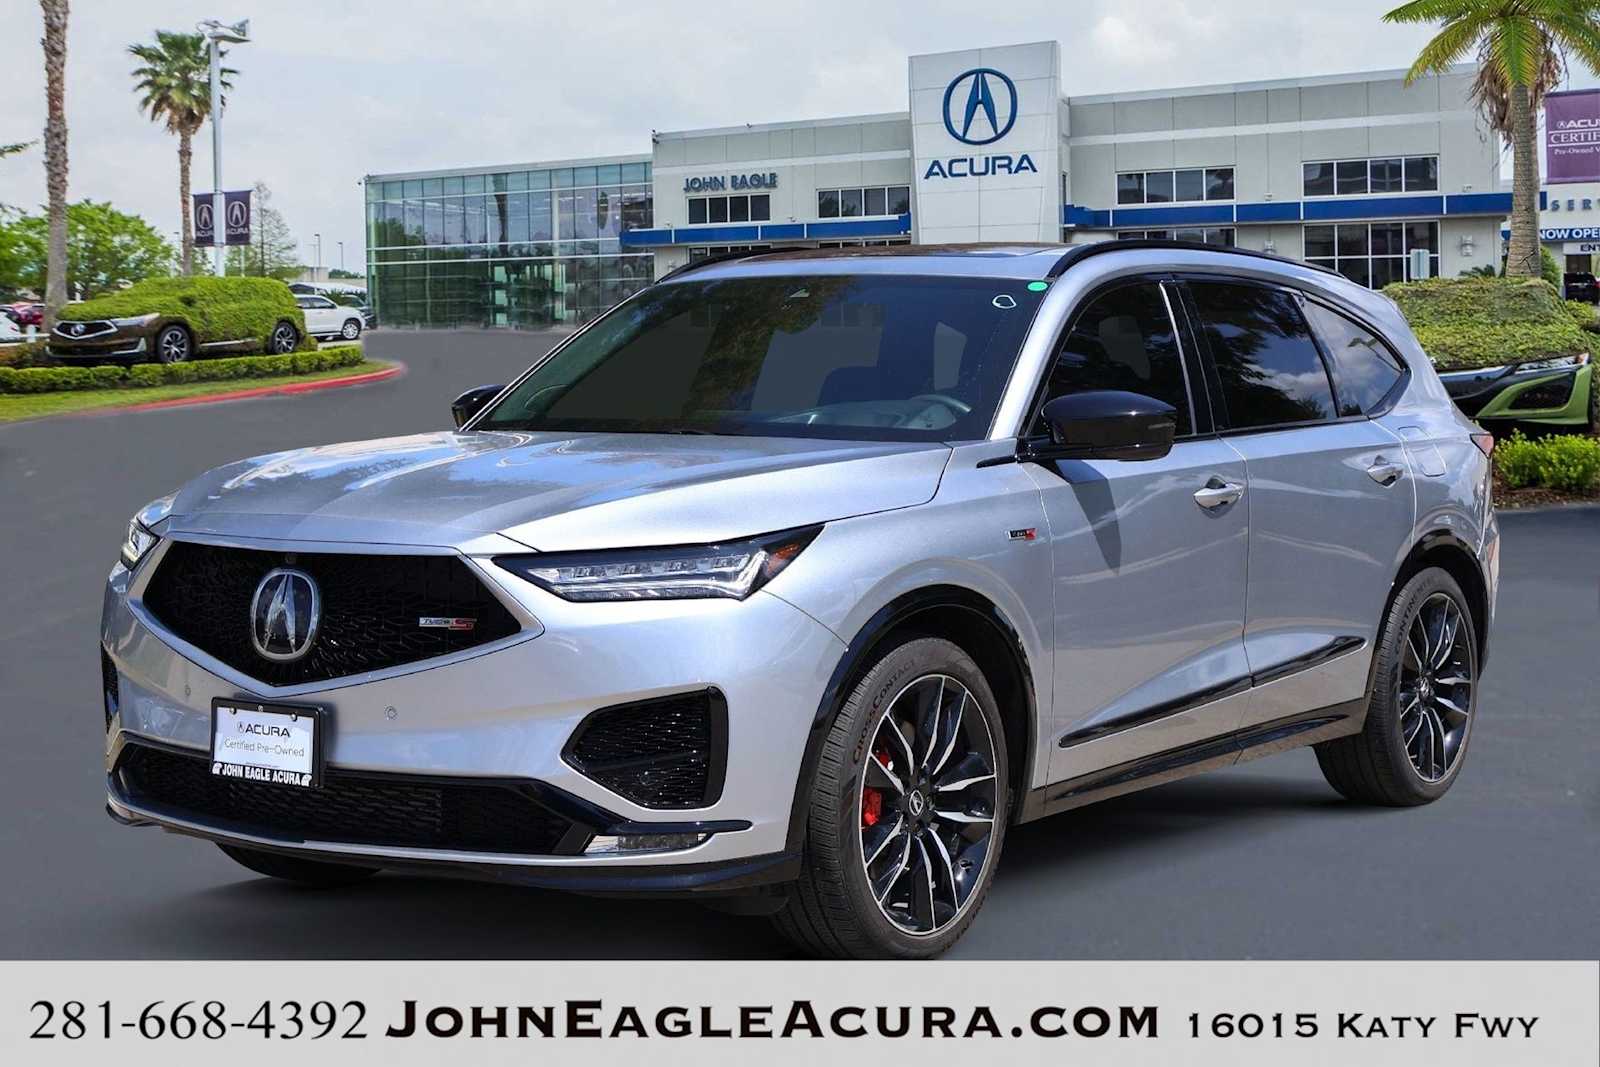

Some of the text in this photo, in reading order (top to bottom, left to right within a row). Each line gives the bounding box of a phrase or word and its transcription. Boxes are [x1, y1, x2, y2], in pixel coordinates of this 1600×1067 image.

[1567, 119, 1600, 128] ACU
[924, 154, 1038, 180] ACURA
[683, 172, 777, 192] JOHN EAGLE
[1540, 228, 1600, 239] NOW OPE
[245, 723, 291, 738] ACURA
[224, 738, 305, 757] Certified Pre-Owned
[222, 763, 243, 778] JOHN
[245, 766, 271, 781] EAGLE
[272, 771, 301, 786] ACURA
